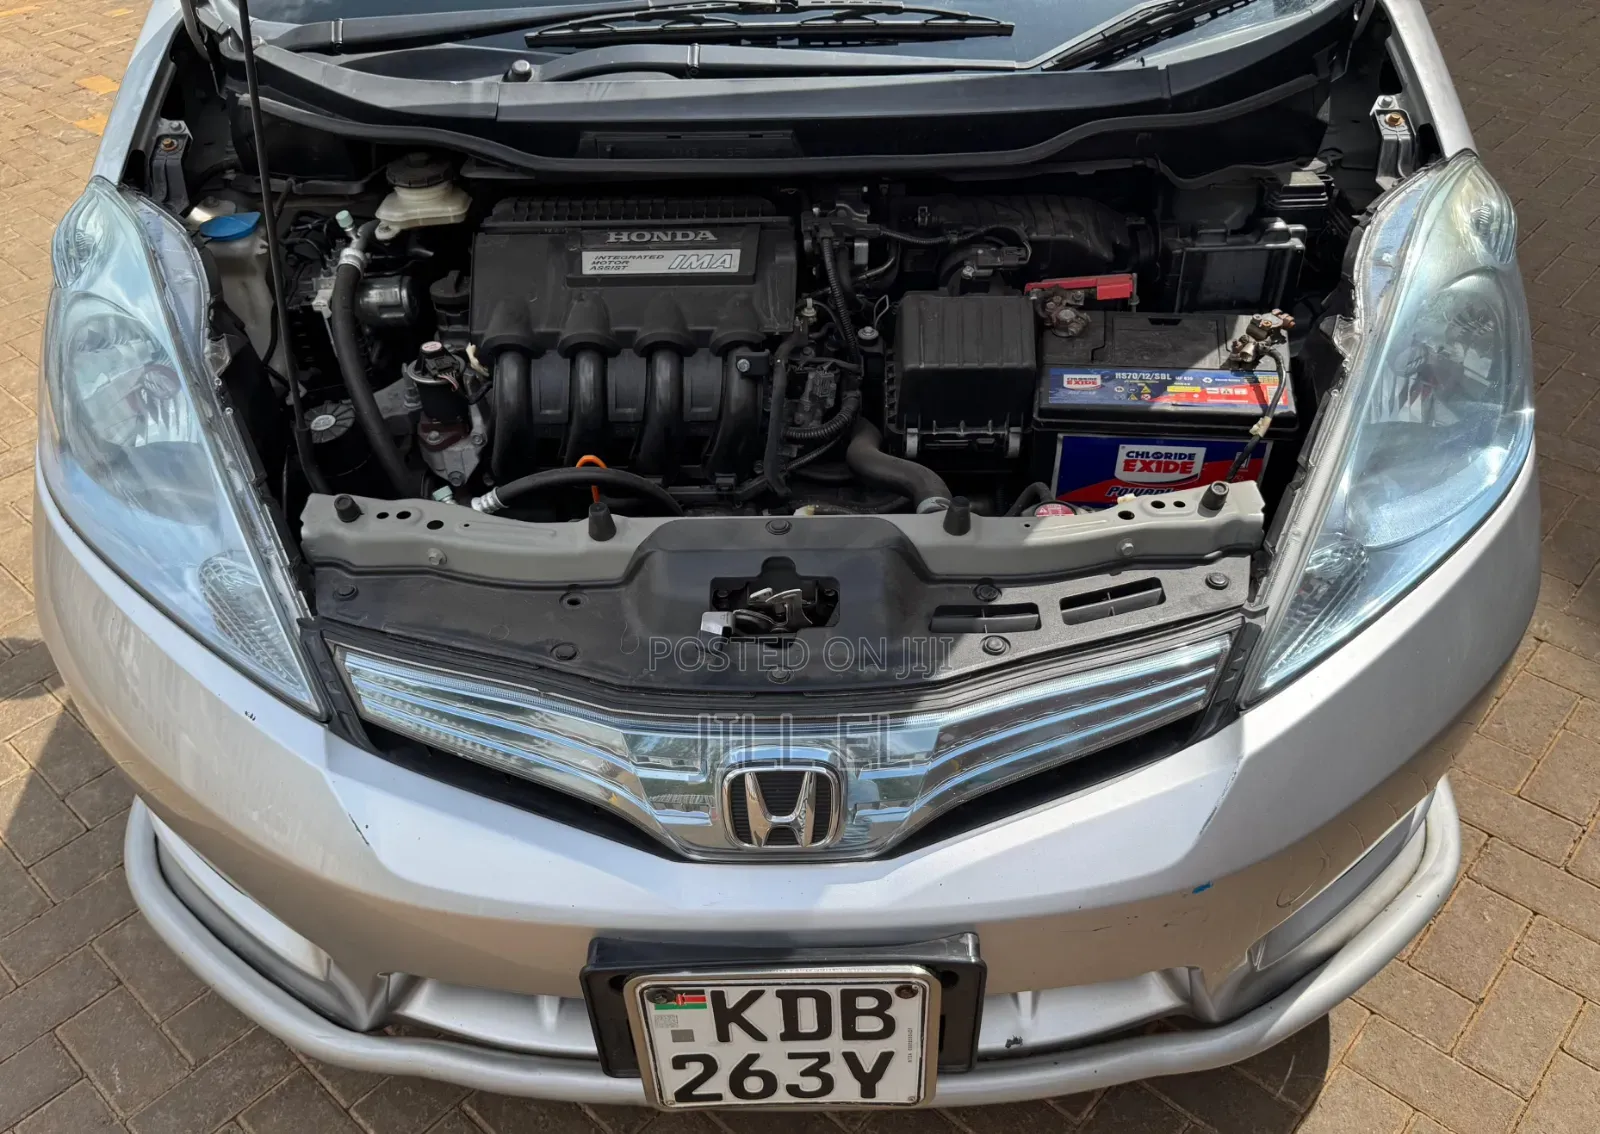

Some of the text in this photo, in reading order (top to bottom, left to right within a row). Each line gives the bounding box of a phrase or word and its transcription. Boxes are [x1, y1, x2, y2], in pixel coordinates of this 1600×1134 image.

[606, 231, 718, 243] HONDA
[668, 253, 733, 270] IMA
[1125, 451, 1196, 460] CHLORIDE
[1122, 459, 1195, 474] EXIDE
[710, 988, 896, 1042] KDB
[671, 1050, 895, 1102] 263Y
